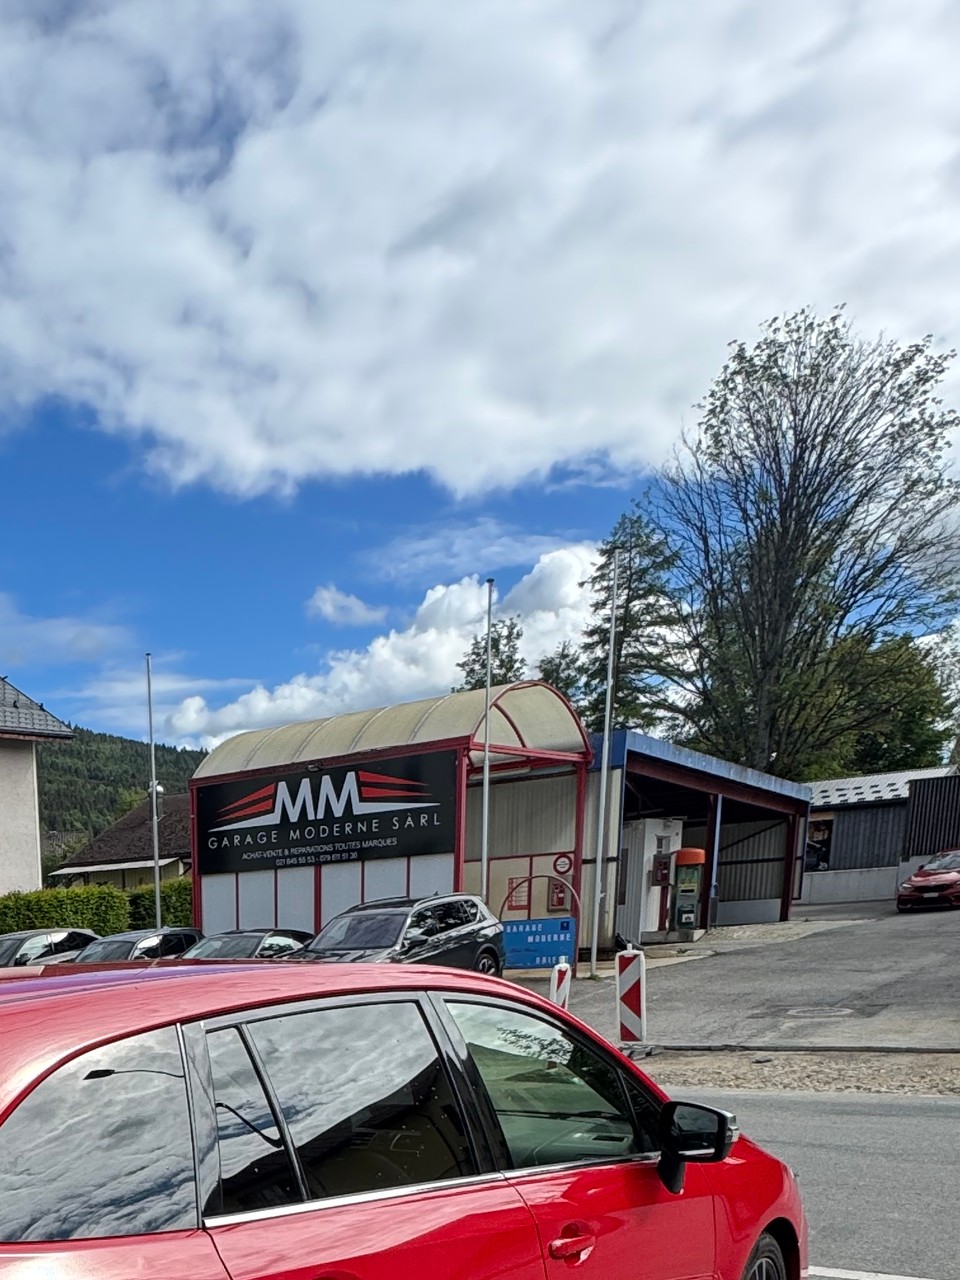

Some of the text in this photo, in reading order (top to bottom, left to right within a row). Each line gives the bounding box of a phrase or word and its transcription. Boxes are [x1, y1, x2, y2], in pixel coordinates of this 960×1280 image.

[208, 830, 279, 850] GARAGE
[289, 818, 380, 841] MODERNE
[334, 840, 361, 851] TOUTES
[362, 837, 398, 848] MARQUES
[506, 923, 543, 933] GARAGE
[527, 933, 571, 943] MODERNE
